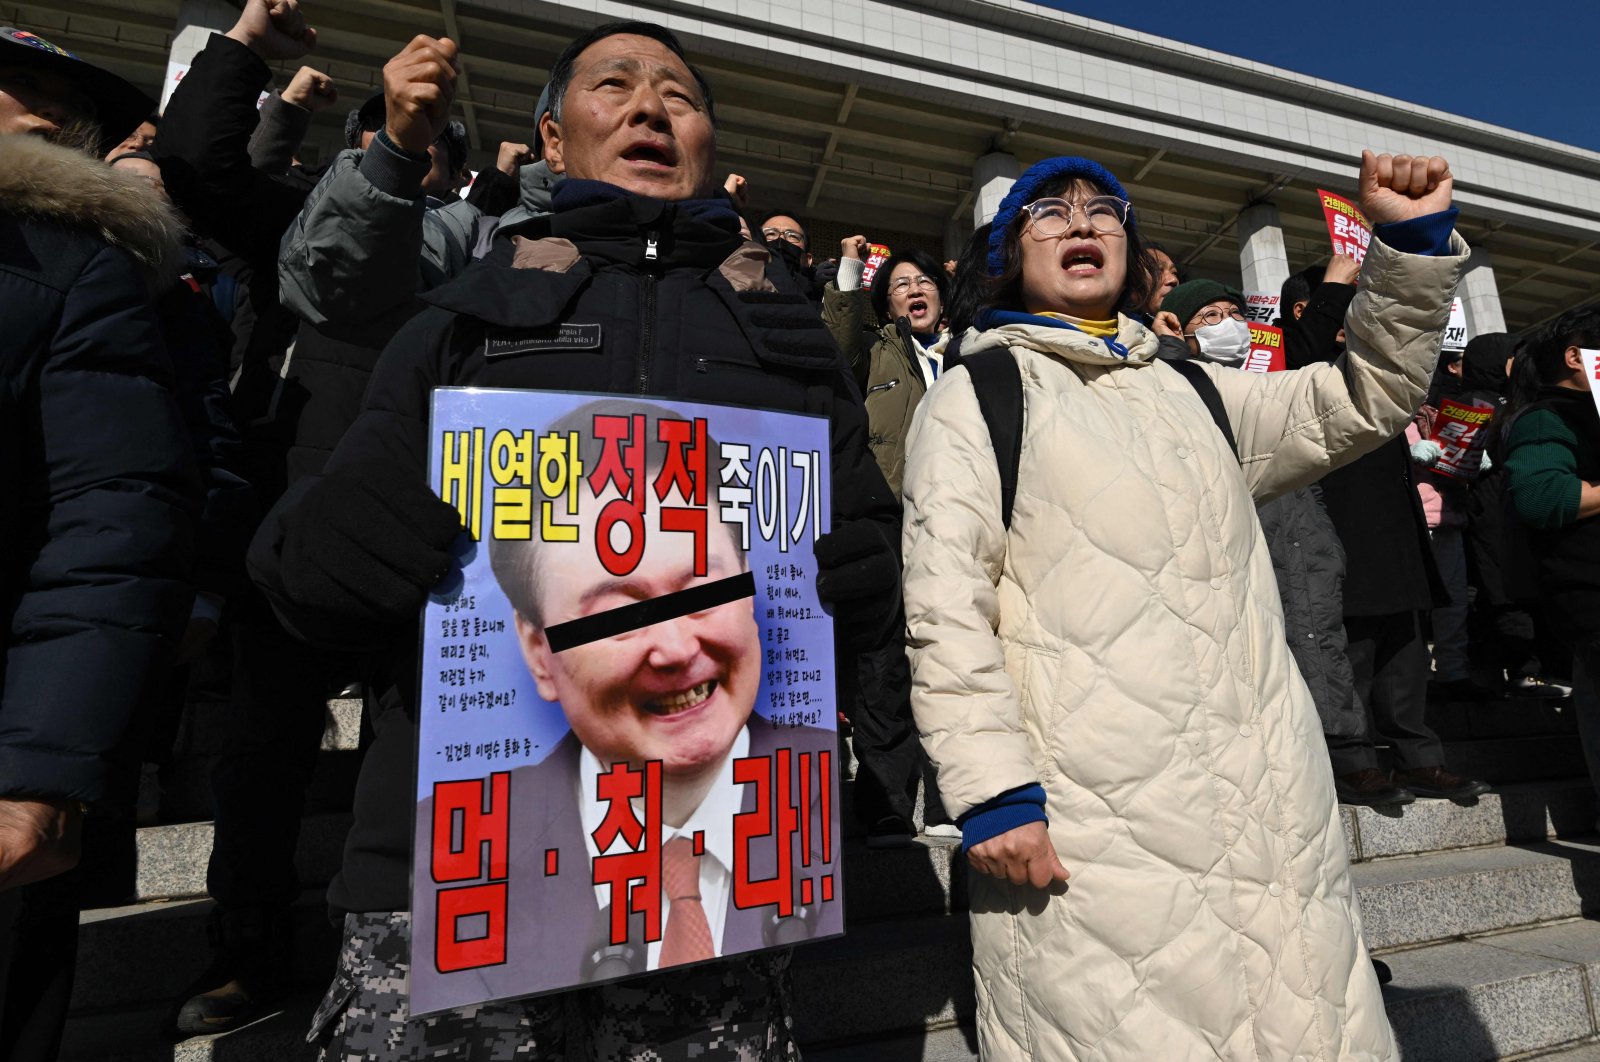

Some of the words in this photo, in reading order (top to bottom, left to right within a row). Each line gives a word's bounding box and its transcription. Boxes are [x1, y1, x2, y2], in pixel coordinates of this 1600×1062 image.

[1248, 328, 1281, 347] 라개입
[1444, 327, 1465, 341] 자!
[440, 427, 583, 543] 비열한
[587, 413, 709, 577] 정적
[718, 441, 821, 553] 죽이기
[766, 564, 787, 580] 인물이
[766, 584, 781, 601] 힘이
[461, 618, 471, 637] 잘
[776, 627, 790, 644] 골고
[441, 645, 466, 659] 데리고
[440, 668, 466, 686] 저런걸
[469, 668, 486, 685] 누가
[802, 669, 821, 682] 다니고
[438, 693, 456, 713] 같이
[459, 689, 516, 712] 살아주겠어요?
[770, 691, 785, 707] 당신
[788, 709, 822, 729] 살겠어요?
[444, 742, 471, 763] 김건희
[475, 740, 500, 761] 이명수
[504, 738, 520, 759] 통화
[523, 738, 532, 758] 중
